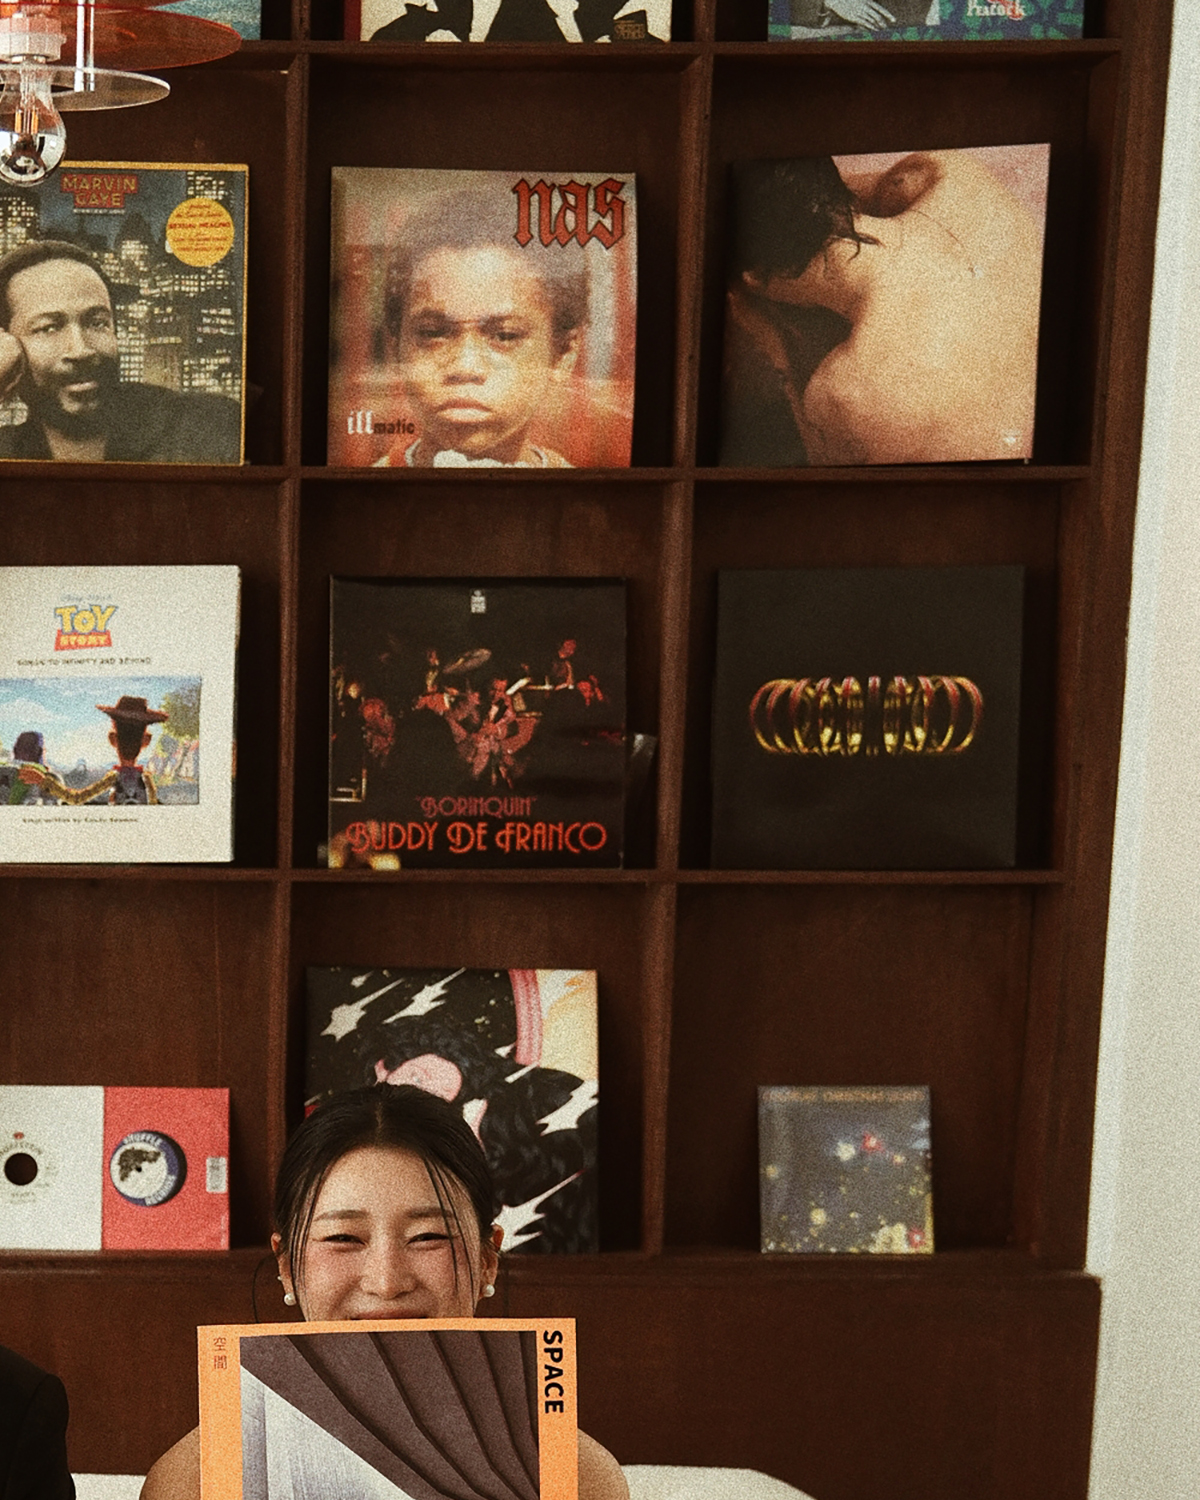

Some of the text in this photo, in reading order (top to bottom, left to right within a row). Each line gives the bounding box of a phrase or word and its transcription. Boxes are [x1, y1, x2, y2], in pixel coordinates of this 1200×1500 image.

[63, 177, 136, 191] MARVIN
[75, 193, 122, 206] GAYE
[511, 178, 626, 250] nas
[54, 603, 119, 635] TOY
[60, 633, 108, 647] STORY
[345, 821, 608, 854] BUDDY DE FRANCO
[213, 1336, 227, 1369] 空間
[543, 1330, 565, 1414] SPACE
